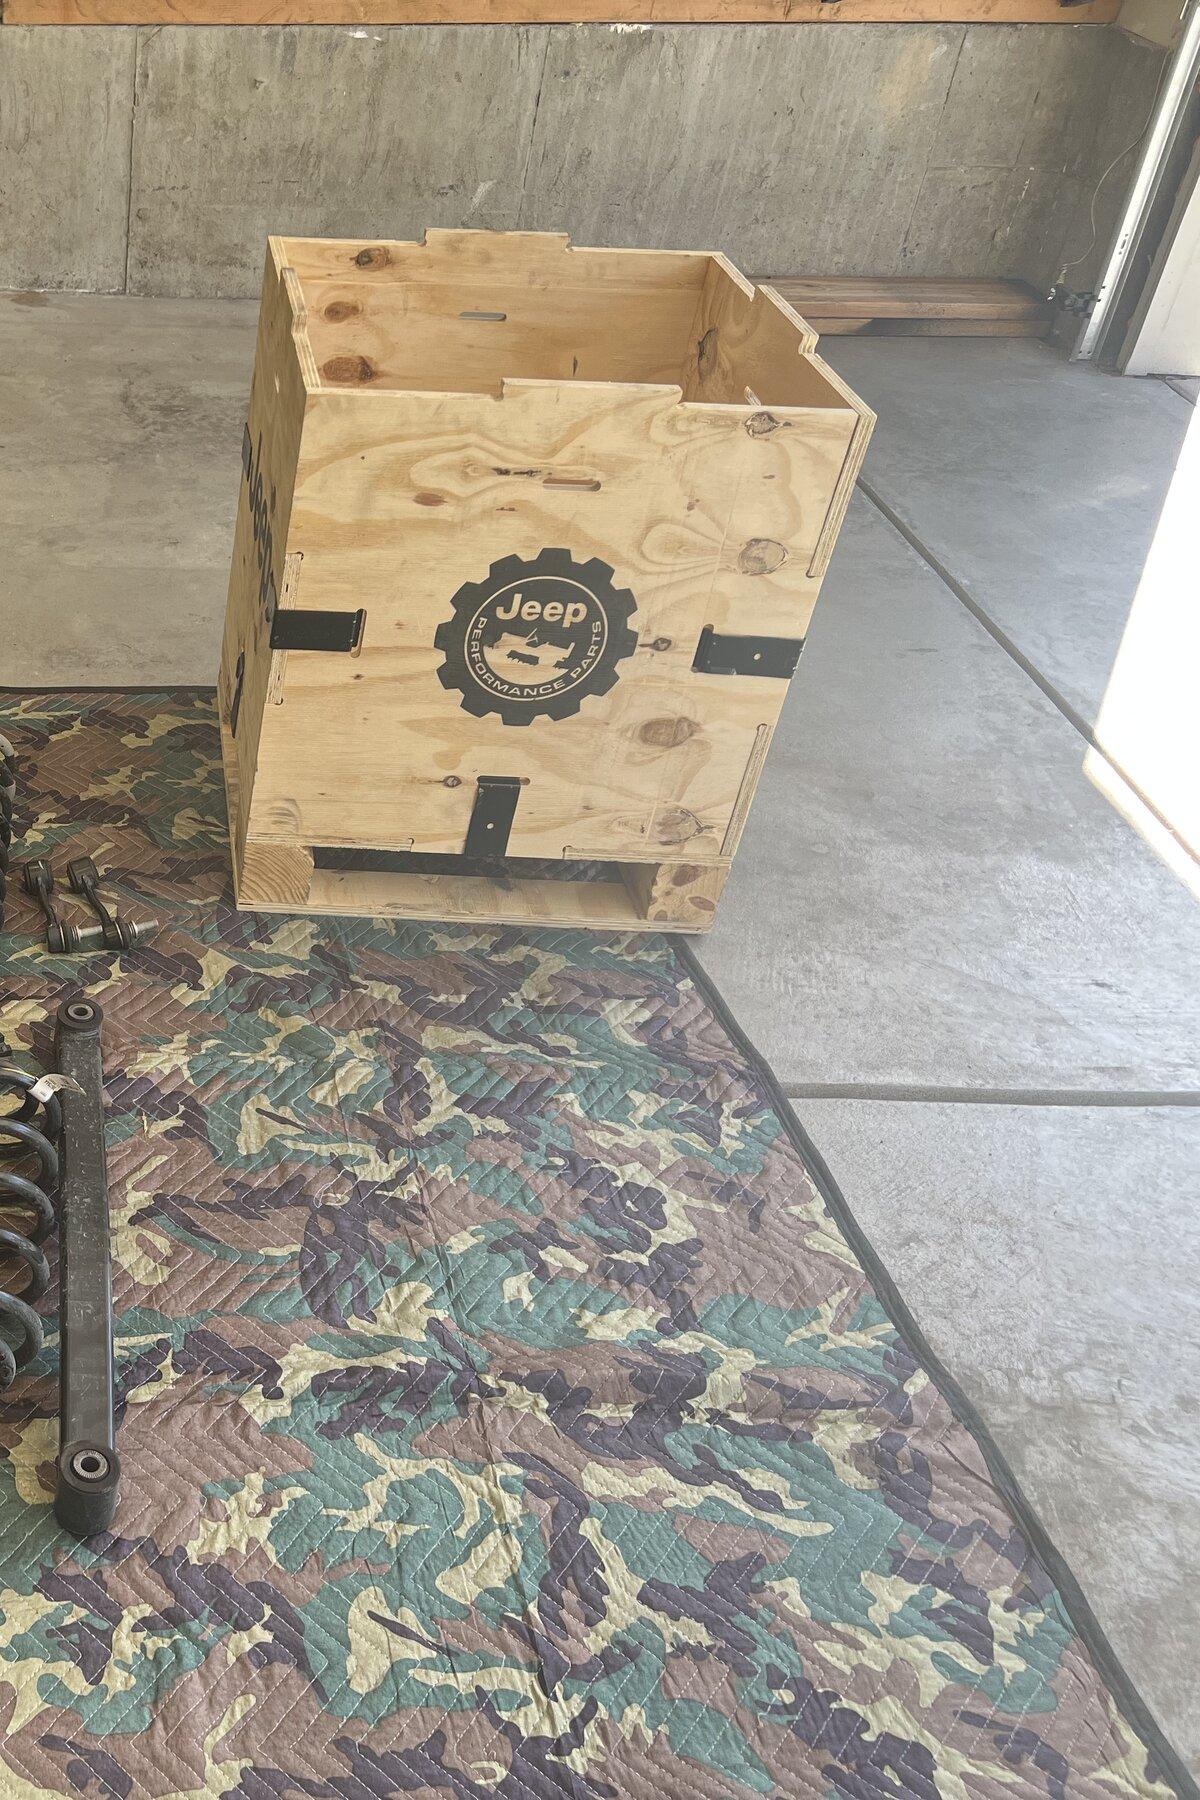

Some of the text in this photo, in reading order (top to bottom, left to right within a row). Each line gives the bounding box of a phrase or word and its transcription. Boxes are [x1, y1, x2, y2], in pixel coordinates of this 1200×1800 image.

[249, 431, 273, 607] Jeep
[495, 593, 588, 628] Jeep
[469, 616, 602, 696] PERFORMANCE PARTS
